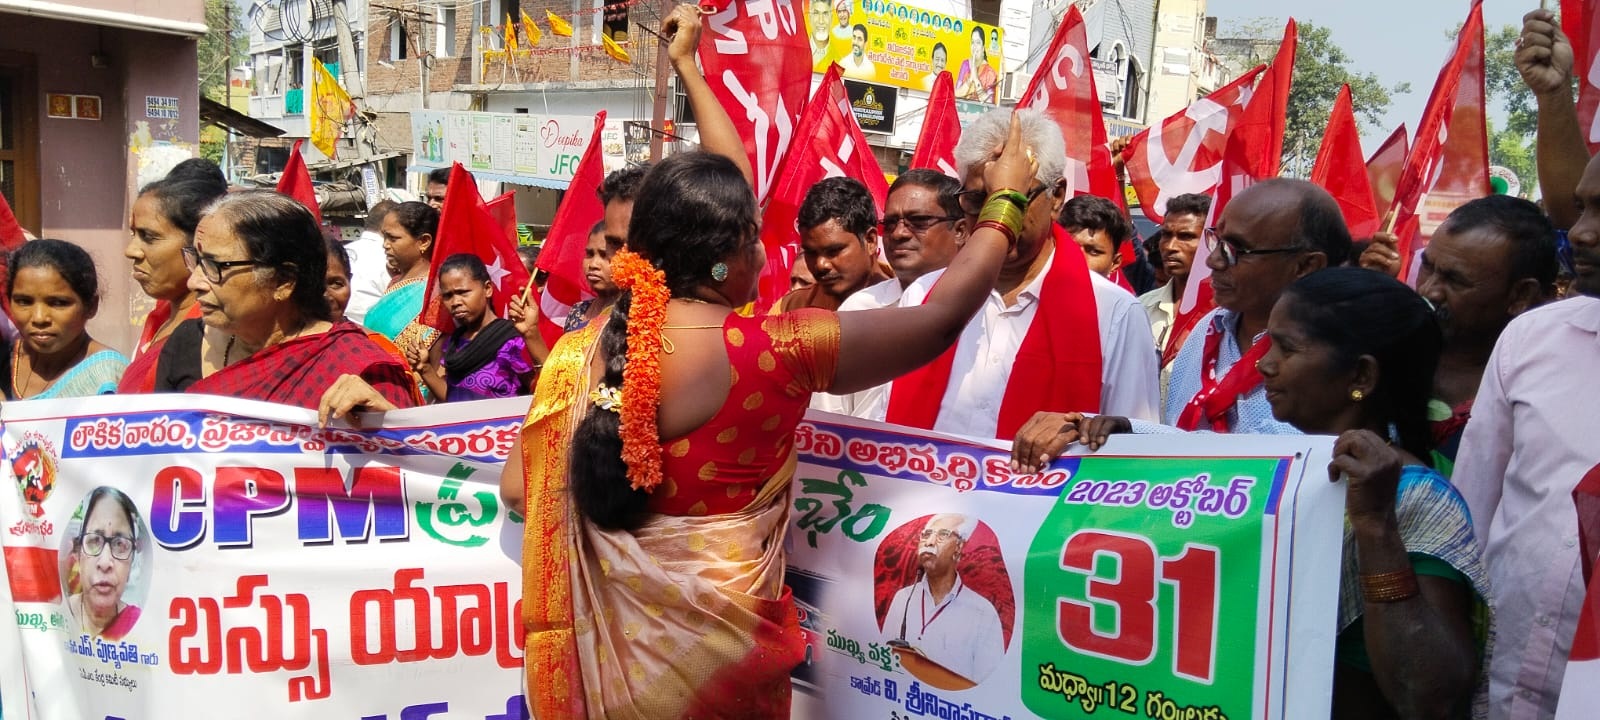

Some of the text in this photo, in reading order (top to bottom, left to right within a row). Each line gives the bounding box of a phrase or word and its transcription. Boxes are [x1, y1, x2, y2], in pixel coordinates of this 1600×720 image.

[541, 120, 583, 152] Deepika
[72, 420, 123, 448] లౌకిక
[125, 417, 193, 446] వాదం,
[849, 440, 977, 493] అభివృద్ధి
[151, 465, 407, 545] CPM
[415, 461, 525, 548] ప్ర
[1067, 475, 1254, 526] 2023 అక్టోబర్
[1059, 531, 1216, 681] 31
[168, 574, 331, 702] బస్సు
[827, 629, 865, 664] ముఖ్య
